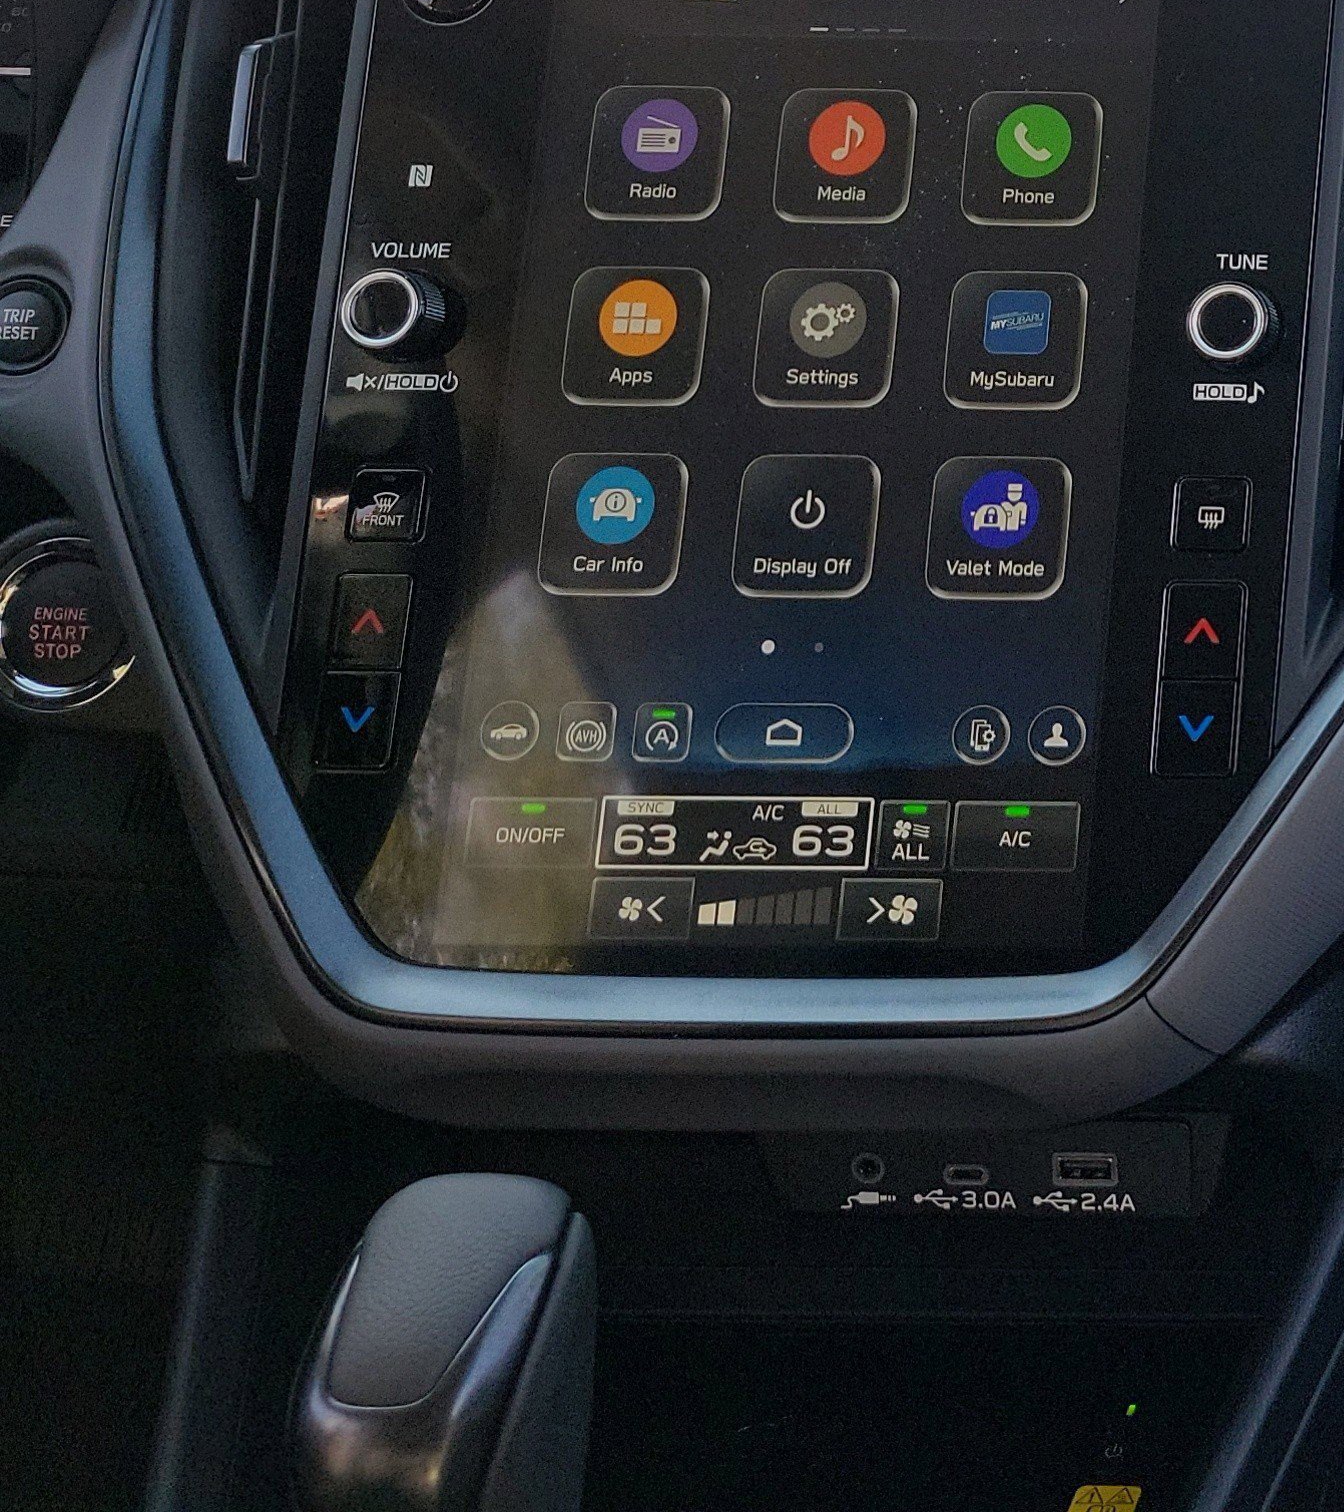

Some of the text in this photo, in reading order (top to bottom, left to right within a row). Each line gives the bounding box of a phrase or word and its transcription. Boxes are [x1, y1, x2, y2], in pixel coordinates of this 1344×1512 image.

[628, 182, 676, 198] Radio
[816, 185, 866, 201] Media
[1002, 188, 1054, 203] Phone
[370, 241, 451, 258] VOLUME
[1215, 253, 1268, 270] TUNE
[3, 308, 35, 323] TRIP
[608, 367, 652, 386] Apps
[785, 368, 858, 388] Settings
[969, 370, 1054, 389] MySubaru
[1194, 384, 1247, 399] HOLD
[362, 513, 404, 527] FRONT
[572, 555, 643, 572] Car Info
[752, 557, 852, 577] Display Off
[945, 559, 1044, 576] Valet Mode
[33, 606, 87, 620] ENGINE
[28, 623, 90, 640] START
[34, 642, 82, 659] STOP
[575, 728, 600, 743] AVH
[626, 802, 666, 814] SYNC
[751, 804, 784, 821] A/C
[816, 803, 843, 815] ALL
[495, 827, 565, 843] ON/OFF
[613, 823, 676, 855] 63
[791, 824, 854, 856] 63
[998, 830, 1031, 847] A/C
[890, 843, 930, 860] ALL
[960, 1190, 1017, 1209] 3.0A
[1079, 1192, 1136, 1211] 2.4A
